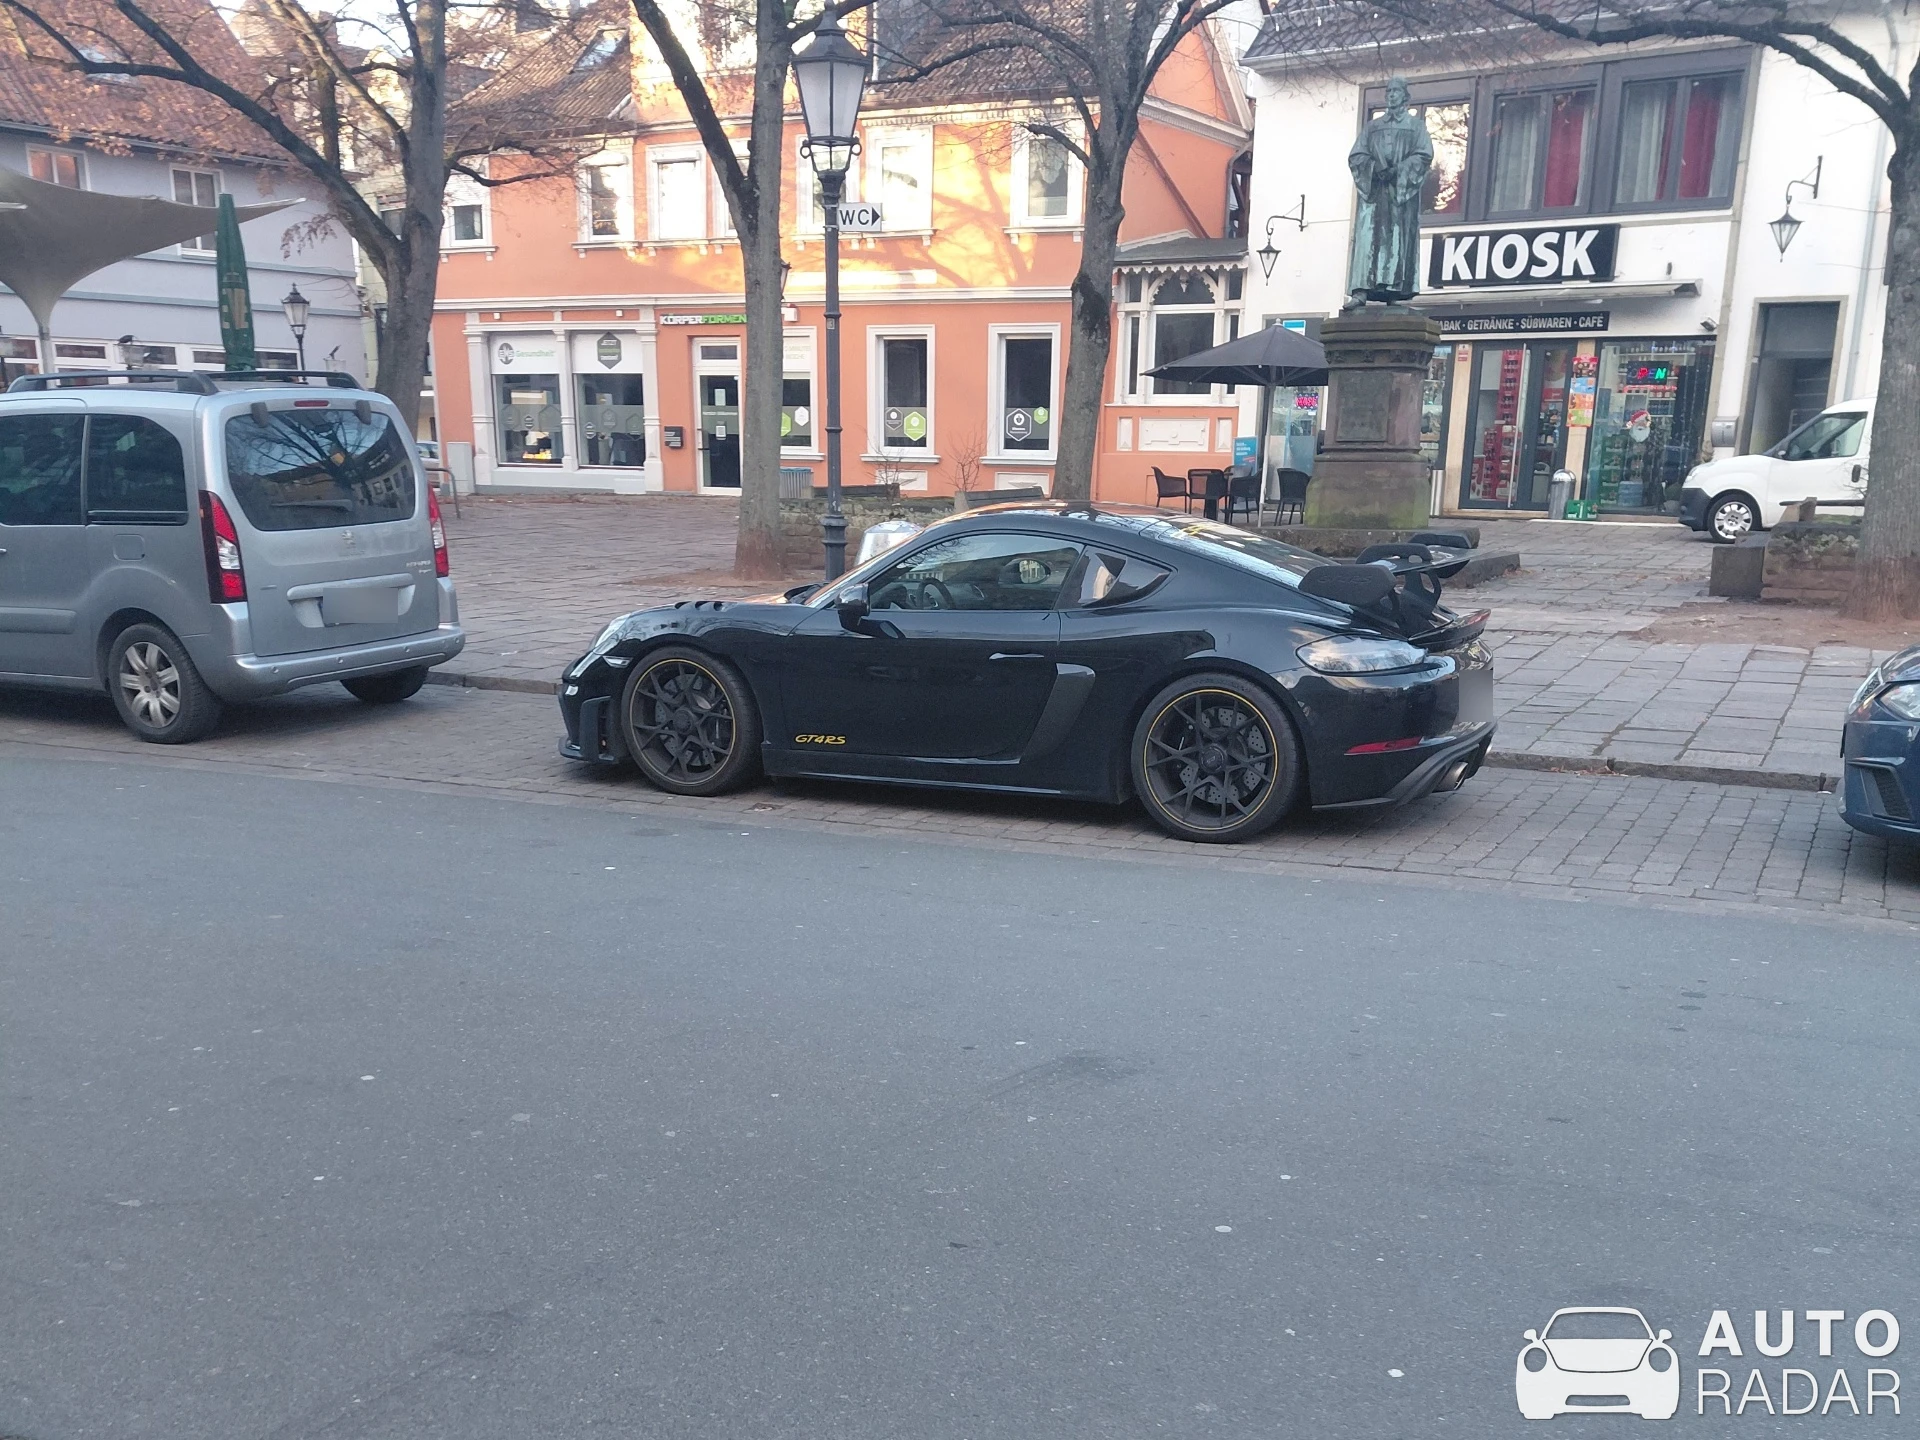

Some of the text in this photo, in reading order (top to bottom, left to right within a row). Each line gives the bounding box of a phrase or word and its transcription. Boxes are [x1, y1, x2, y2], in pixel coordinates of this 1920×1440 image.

[839, 208, 870, 226] WC
[1440, 228, 1599, 281] KIOSK
[1436, 319, 1461, 331] ABAK
[1467, 316, 1514, 331] GETRÄNKE
[1578, 313, 1604, 328] CAFÉ
[1630, 367, 1667, 380] OPEN
